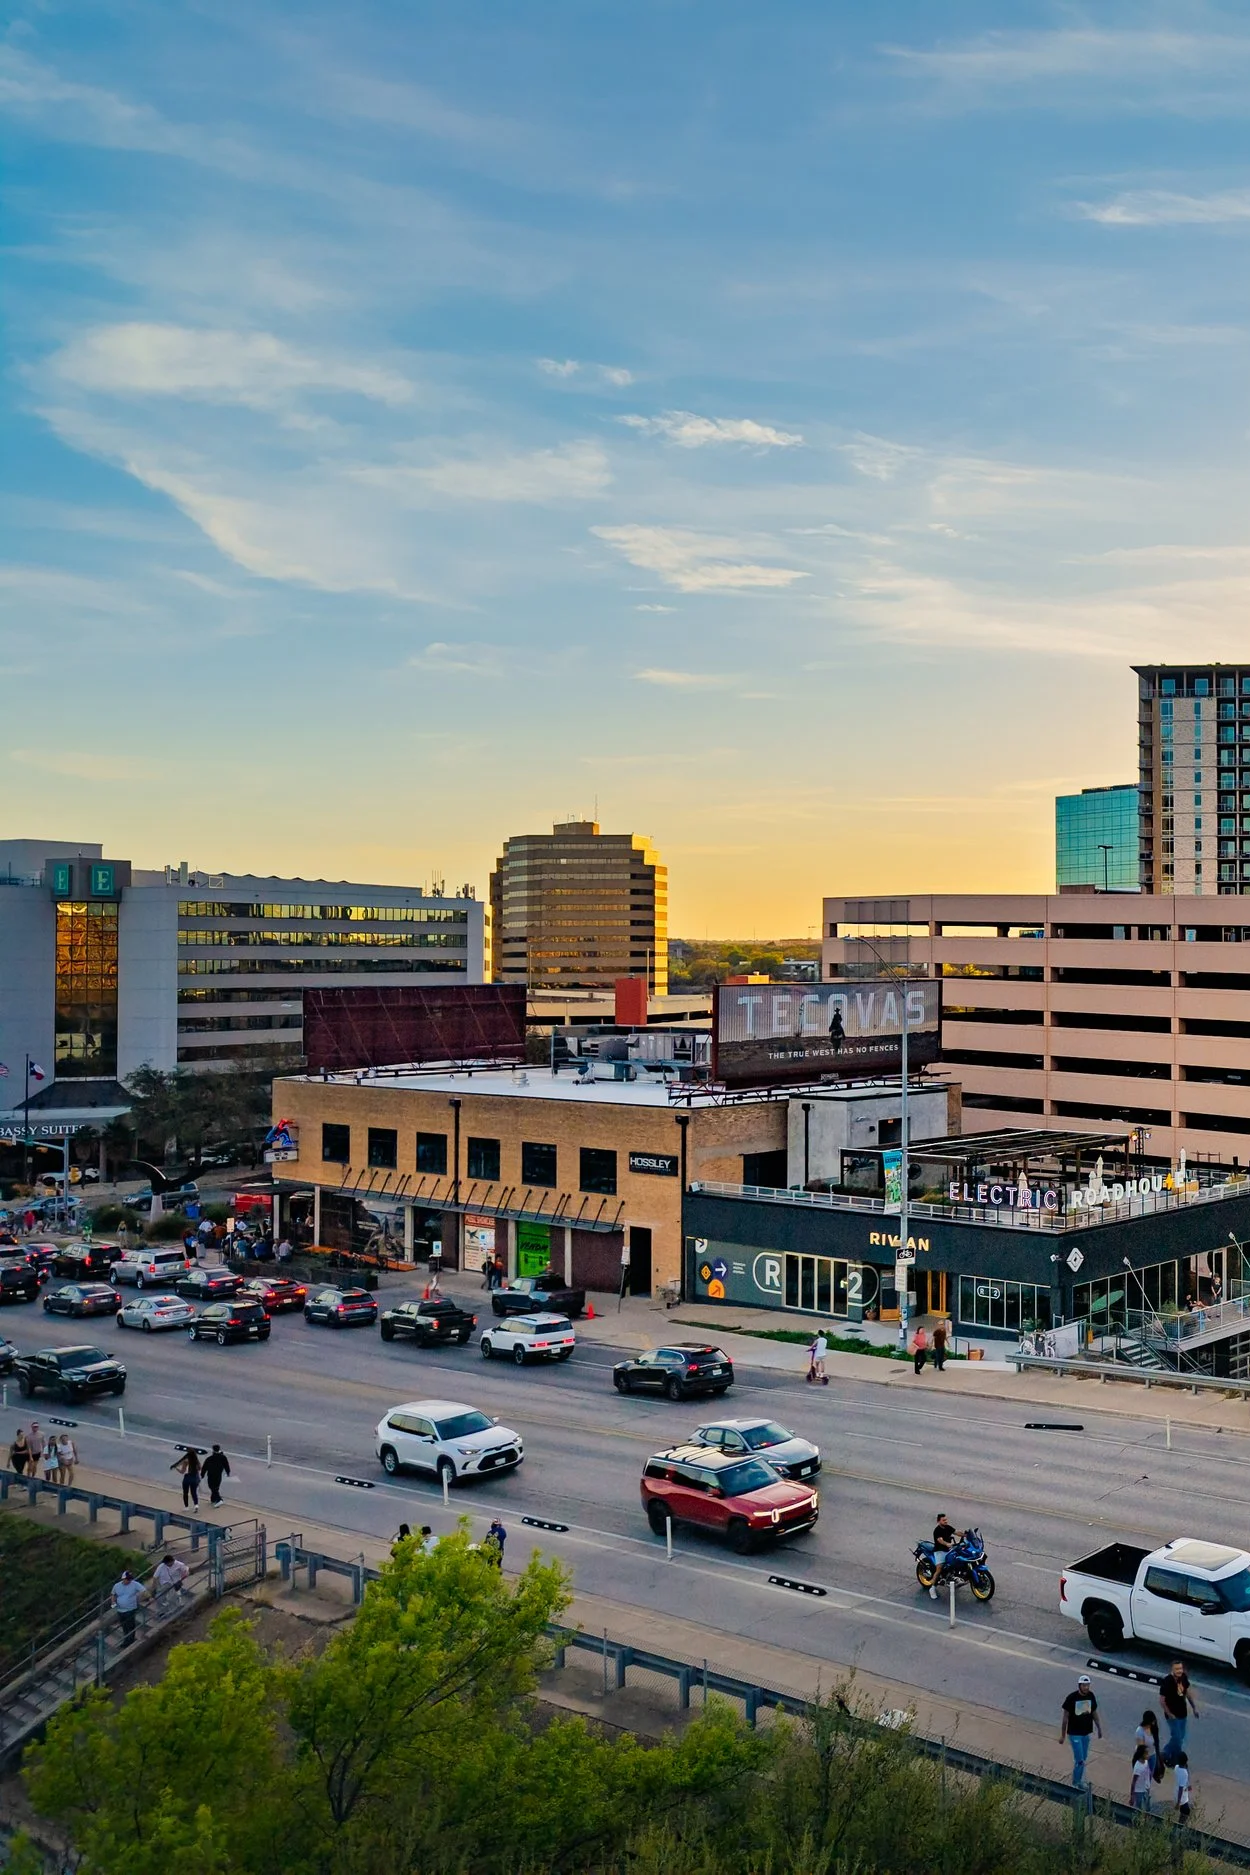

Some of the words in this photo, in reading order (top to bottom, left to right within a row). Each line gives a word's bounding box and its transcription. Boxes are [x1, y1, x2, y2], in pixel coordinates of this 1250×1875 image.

[737, 989, 925, 1036] TECOVAS
[768, 1052, 785, 1060] THE
[788, 1050, 810, 1058] TRUE
[812, 1048, 835, 1057] WEST
[837, 1046, 854, 1055] HAS
[869, 1044, 899, 1052] FENCES
[630, 1157, 671, 1169] HOSSLEY
[949, 1181, 1057, 1210] ELECTRIC
[869, 1232, 930, 1252] RIVAN
